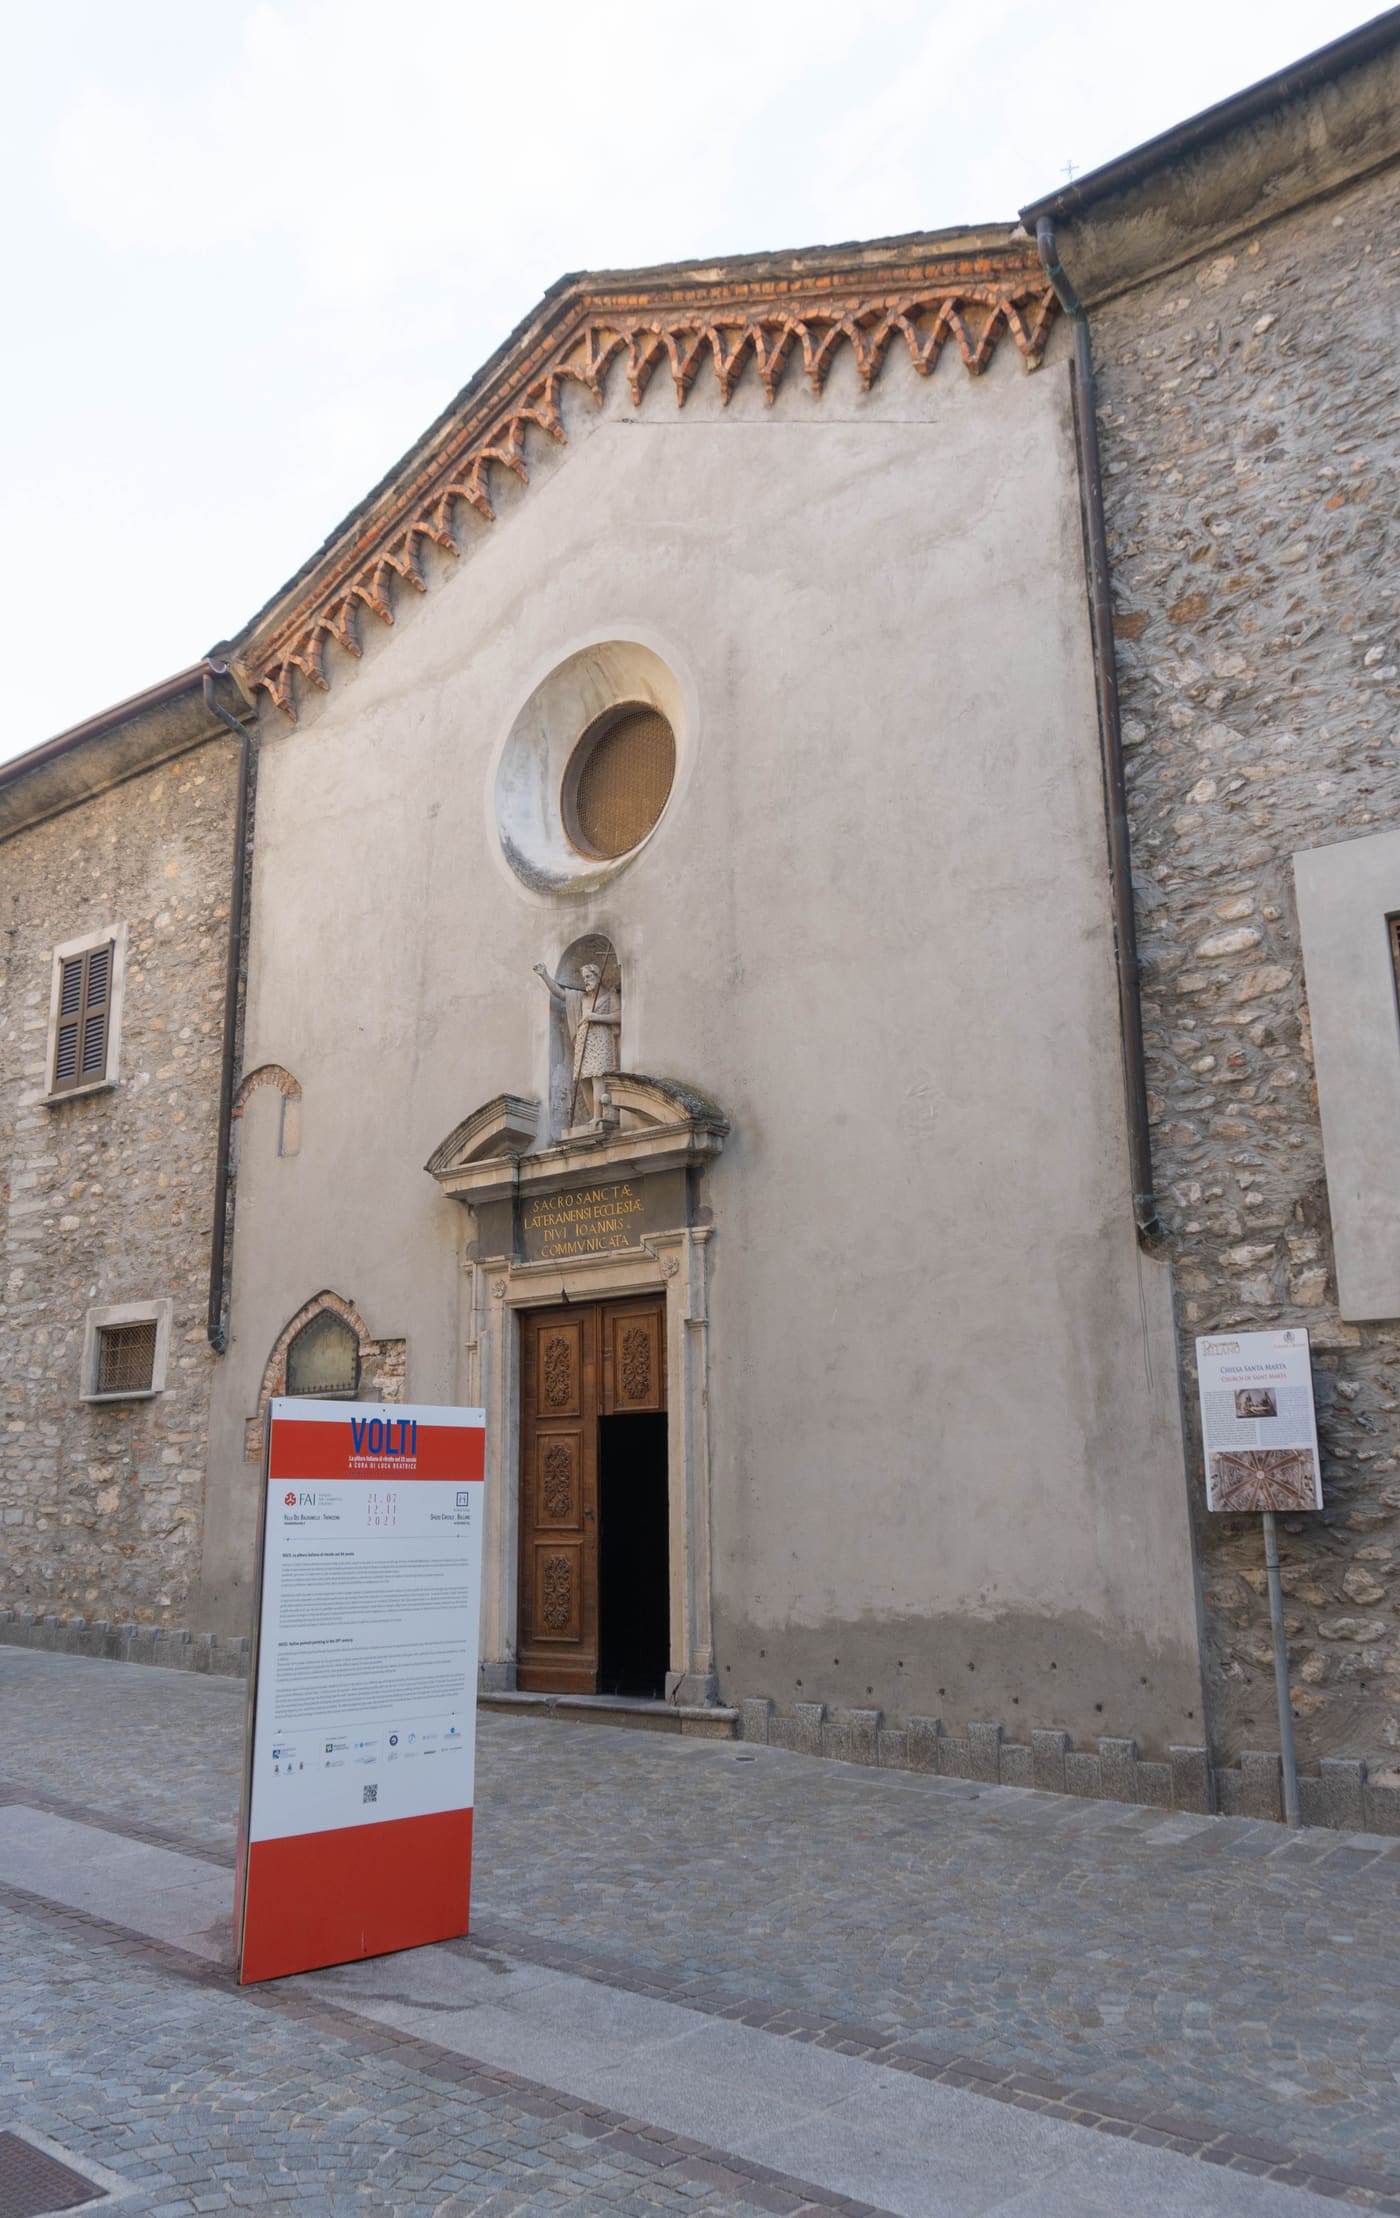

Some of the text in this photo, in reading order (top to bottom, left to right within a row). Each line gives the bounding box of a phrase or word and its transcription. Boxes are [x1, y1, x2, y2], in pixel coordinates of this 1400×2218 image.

[524, 1207, 592, 1230] LATERANENSI
[541, 1233, 630, 1258] COMMVNICATA
[544, 1229, 567, 1242] DIVI
[351, 1417, 417, 1455] VOLTI
[299, 1493, 316, 1506] FAI
